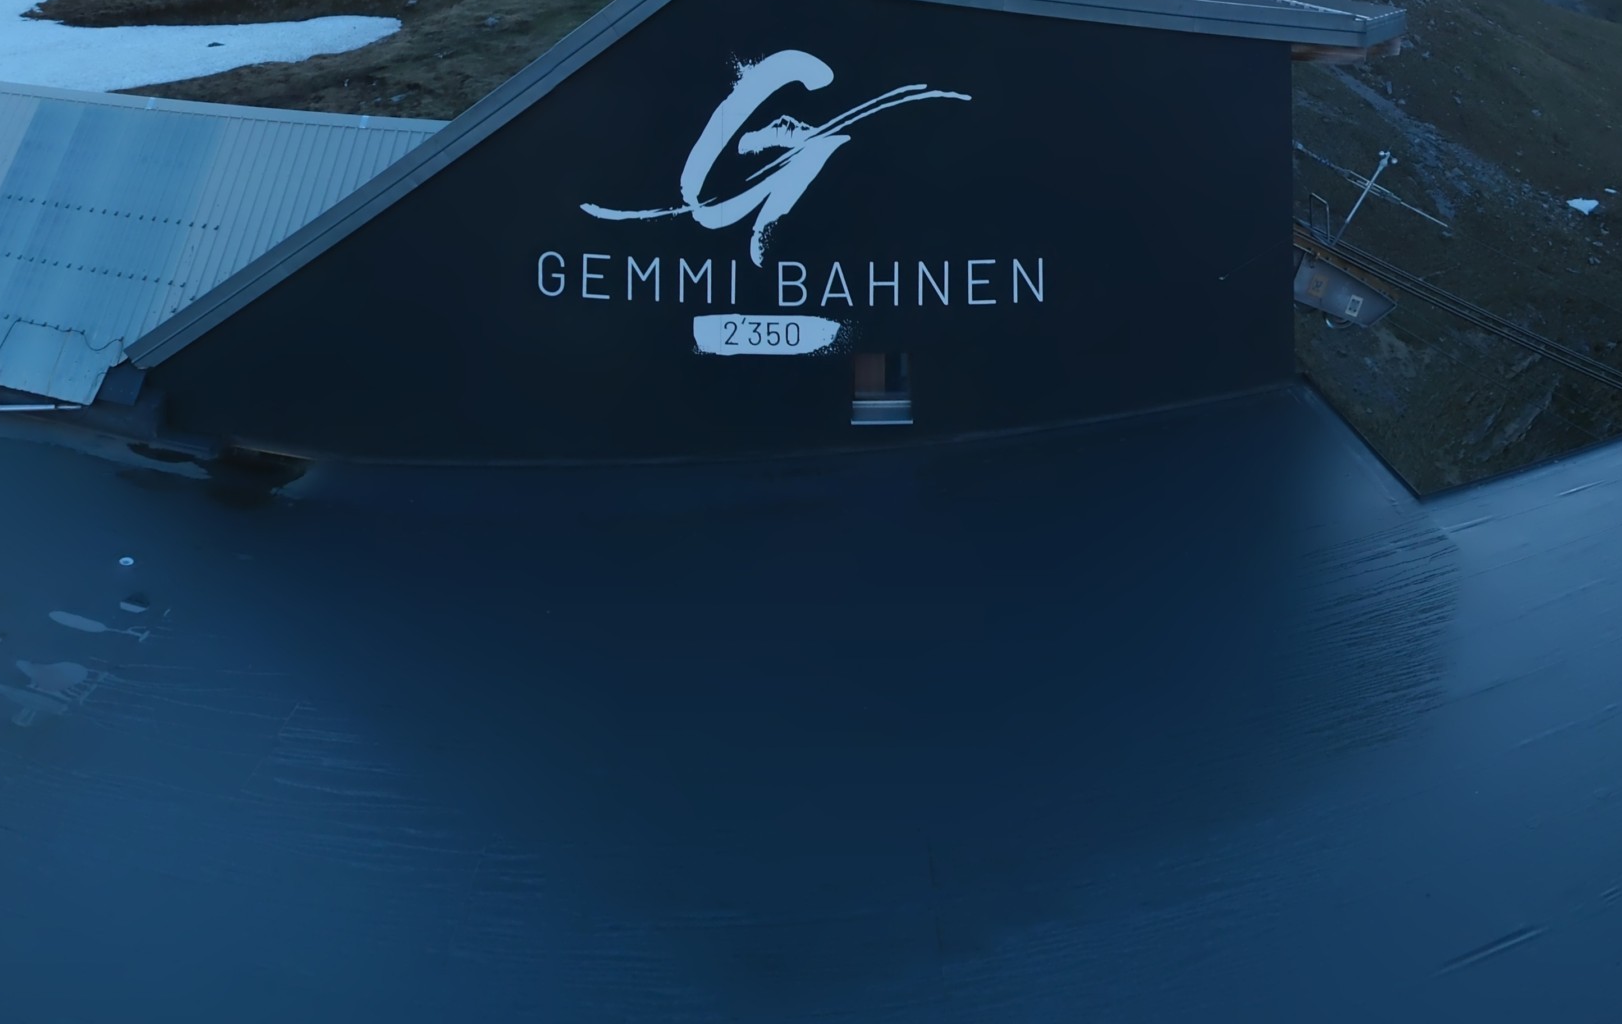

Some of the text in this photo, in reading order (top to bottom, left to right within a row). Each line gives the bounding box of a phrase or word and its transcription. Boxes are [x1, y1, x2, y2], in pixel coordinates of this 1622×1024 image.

[537, 251, 1045, 308] GEMMI BAHNEN
[723, 317, 801, 347] 2'350
